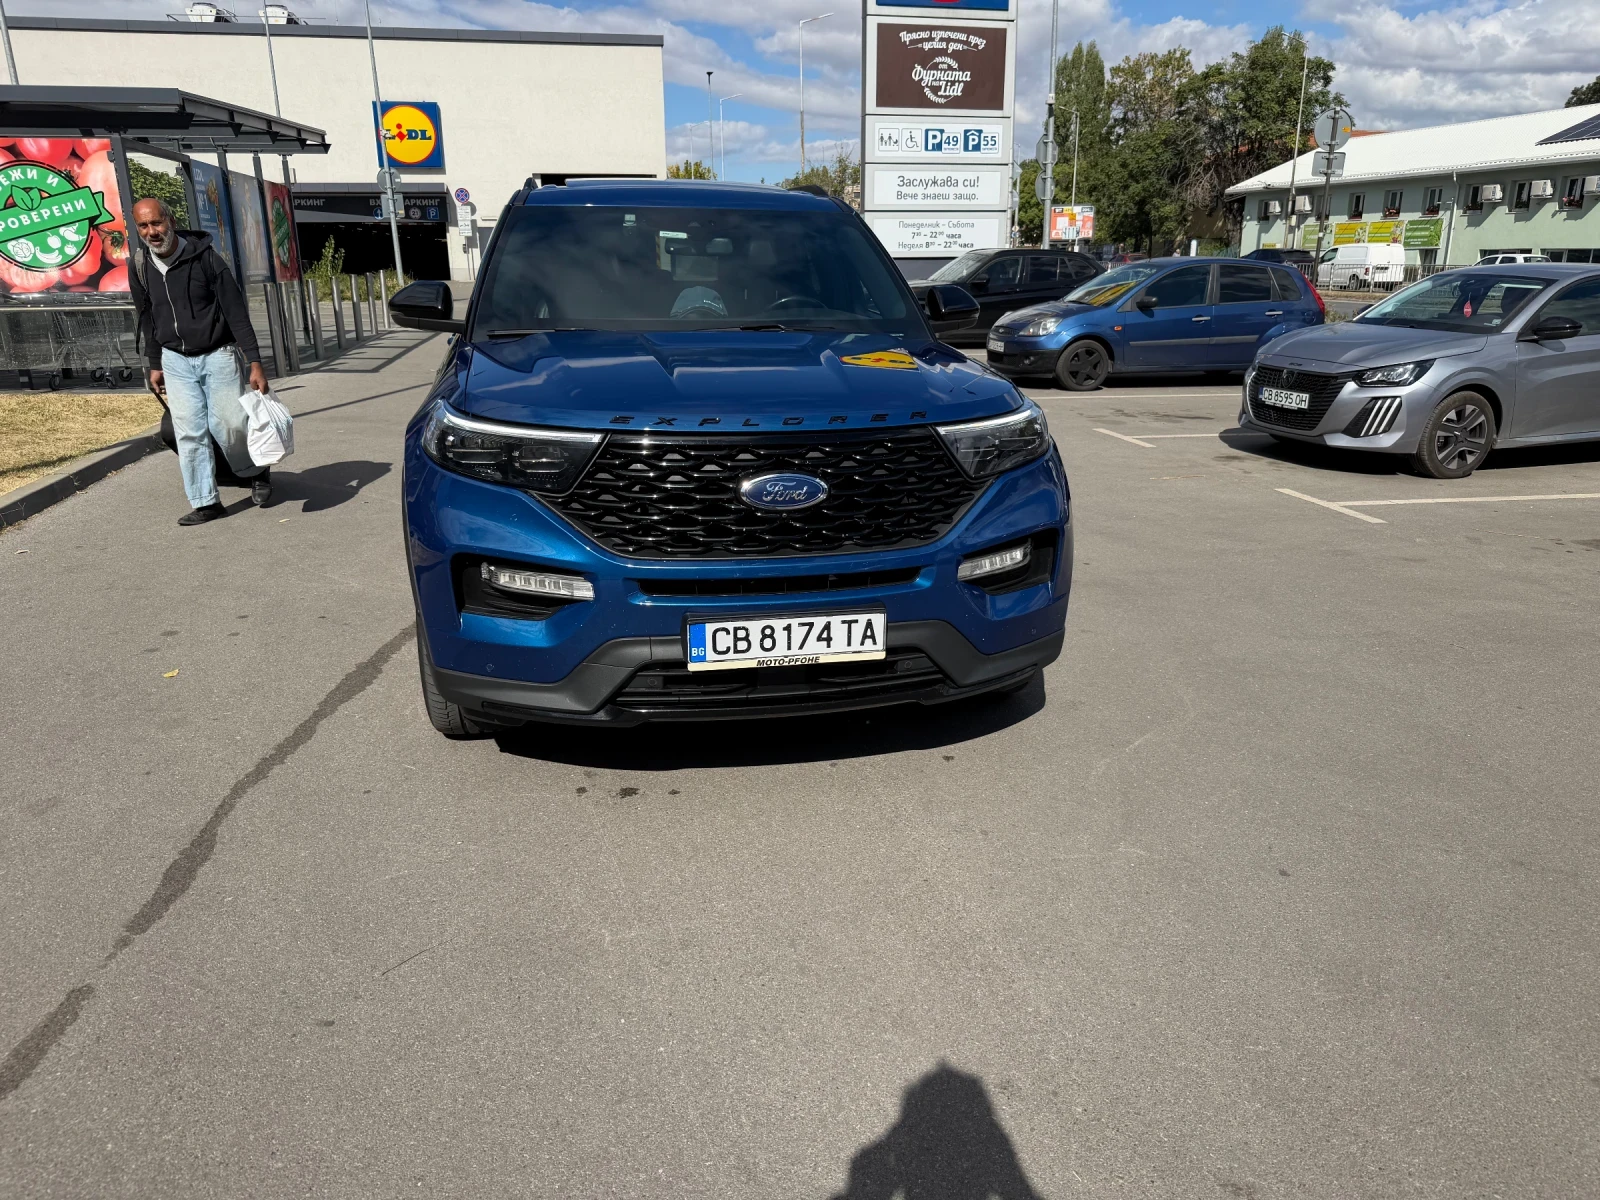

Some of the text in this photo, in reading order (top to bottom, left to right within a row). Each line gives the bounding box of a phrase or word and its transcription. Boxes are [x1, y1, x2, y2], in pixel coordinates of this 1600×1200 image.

[899, 30, 987, 50] Прясно изпечени през
[922, 41, 963, 53] целия ден
[911, 63, 971, 87] Фурната
[938, 81, 964, 96] Lidl
[943, 135, 959, 147] 49
[982, 135, 997, 147] 55
[0, 168, 38, 191] ЕЖИ
[897, 175, 980, 190] Заслужава си!
[404, 198, 440, 206] АРКИНГ
[896, 190, 979, 202] Вече знаеш защо.
[0, 198, 87, 233] РОВЕРЕНИ
[898, 220, 940, 231] Понеделник
[947, 221, 975, 229] Събота
[898, 241, 923, 251] Неделя
[1263, 388, 1273, 401] CB
[1274, 390, 1294, 405] 8595
[1295, 394, 1308, 408] OH
[609, 410, 927, 427] EXPLORER
[762, 481, 808, 502] Ford
[711, 618, 878, 656] CB 8174 TA
[691, 647, 705, 657] BG
[756, 656, 820, 667] MOTO-PFOHE
